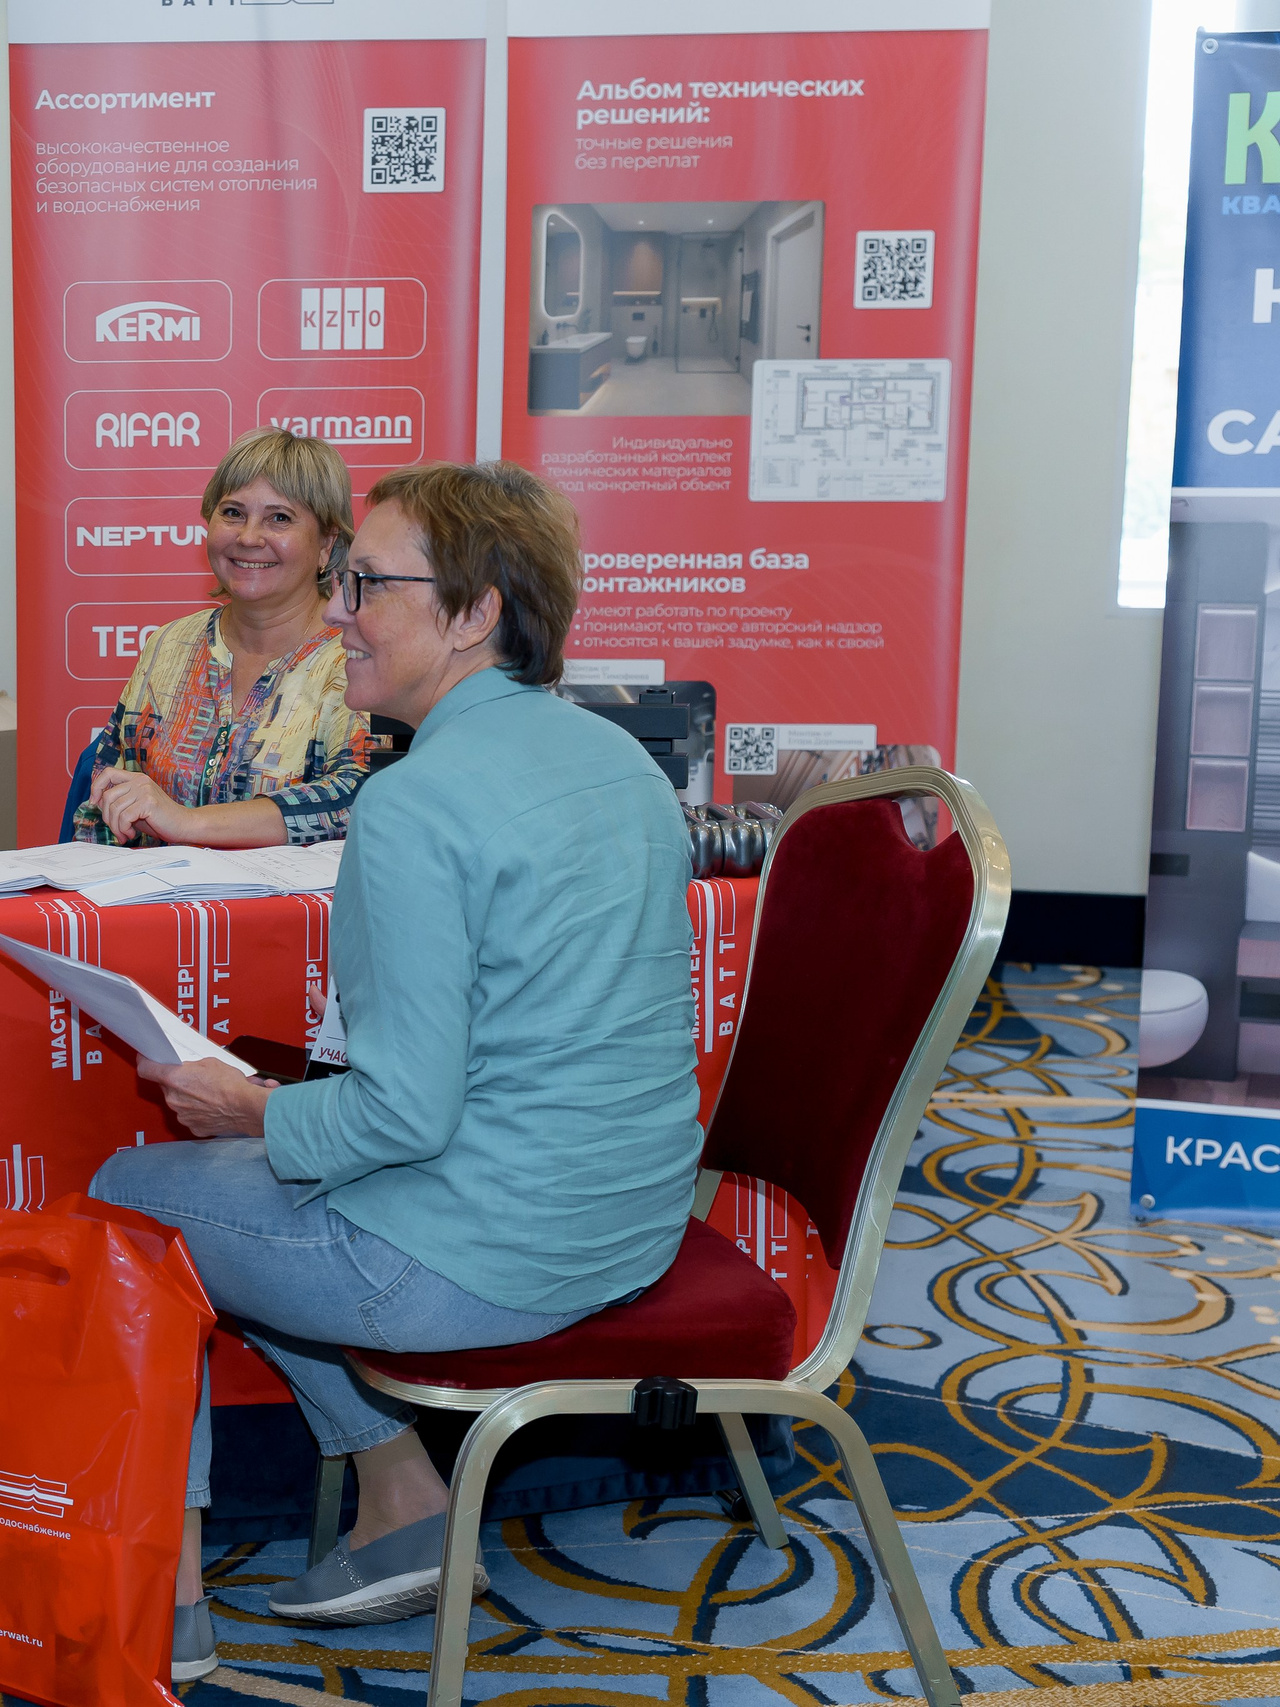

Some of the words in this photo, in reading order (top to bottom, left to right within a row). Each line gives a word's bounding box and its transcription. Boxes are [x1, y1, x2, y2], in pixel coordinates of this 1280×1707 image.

[577, 78, 682, 100] Альбом
[689, 78, 864, 98] технических
[35, 90, 216, 113] Ассортимент
[577, 102, 710, 129] решений:
[36, 140, 230, 155] высококачественное
[576, 136, 642, 150] точные
[646, 135, 733, 152] решения
[36, 157, 170, 177] оборудование
[174, 159, 208, 175] для
[212, 157, 299, 175] создания
[575, 154, 607, 169] без
[612, 154, 700, 170] переплат
[36, 178, 146, 194] безопасных
[150, 179, 215, 194] систем
[219, 177, 317, 194] отопления
[36, 200, 48, 213] и
[53, 197, 200, 214] водоснабжения
[95, 301, 200, 342] KERMI
[304, 309, 381, 328] KZTO
[96, 411, 200, 448] RIFAR
[271, 415, 412, 438] varmann
[612, 437, 733, 452] Индивидуально
[541, 451, 658, 465] разработанный
[661, 452, 732, 464] комплект
[547, 466, 639, 478] технических
[642, 466, 732, 478] материалов
[558, 480, 585, 492] под
[588, 479, 677, 492] конкретный
[680, 478, 731, 492] объект
[578, 552, 743, 574] роверенная
[749, 548, 809, 569] база
[578, 576, 746, 593] онтажников
[584, 606, 633, 618] умеют
[635, 604, 703, 618] работать
[707, 607, 726, 617] по
[729, 606, 792, 619] проекту
[584, 621, 665, 635] понимают,
[667, 622, 692, 633] что
[696, 622, 738, 633] такое
[741, 621, 822, 634] авторский
[826, 622, 882, 635] надзор
[583, 637, 658, 648] относятся
[662, 637, 671, 648] к
[674, 635, 724, 648] вашей
[797, 637, 824, 648] как
[827, 637, 835, 648] к
[838, 635, 884, 648] своей
[719, 940, 736, 1036] ВАТТ
[178, 969, 194, 1027] СТЕР
[213, 968, 230, 1049] АТТ
[49, 985, 67, 1069] МАСТЕ
[86, 1022, 102, 1064] ВА
[771, 1241, 787, 1280] ТТ
